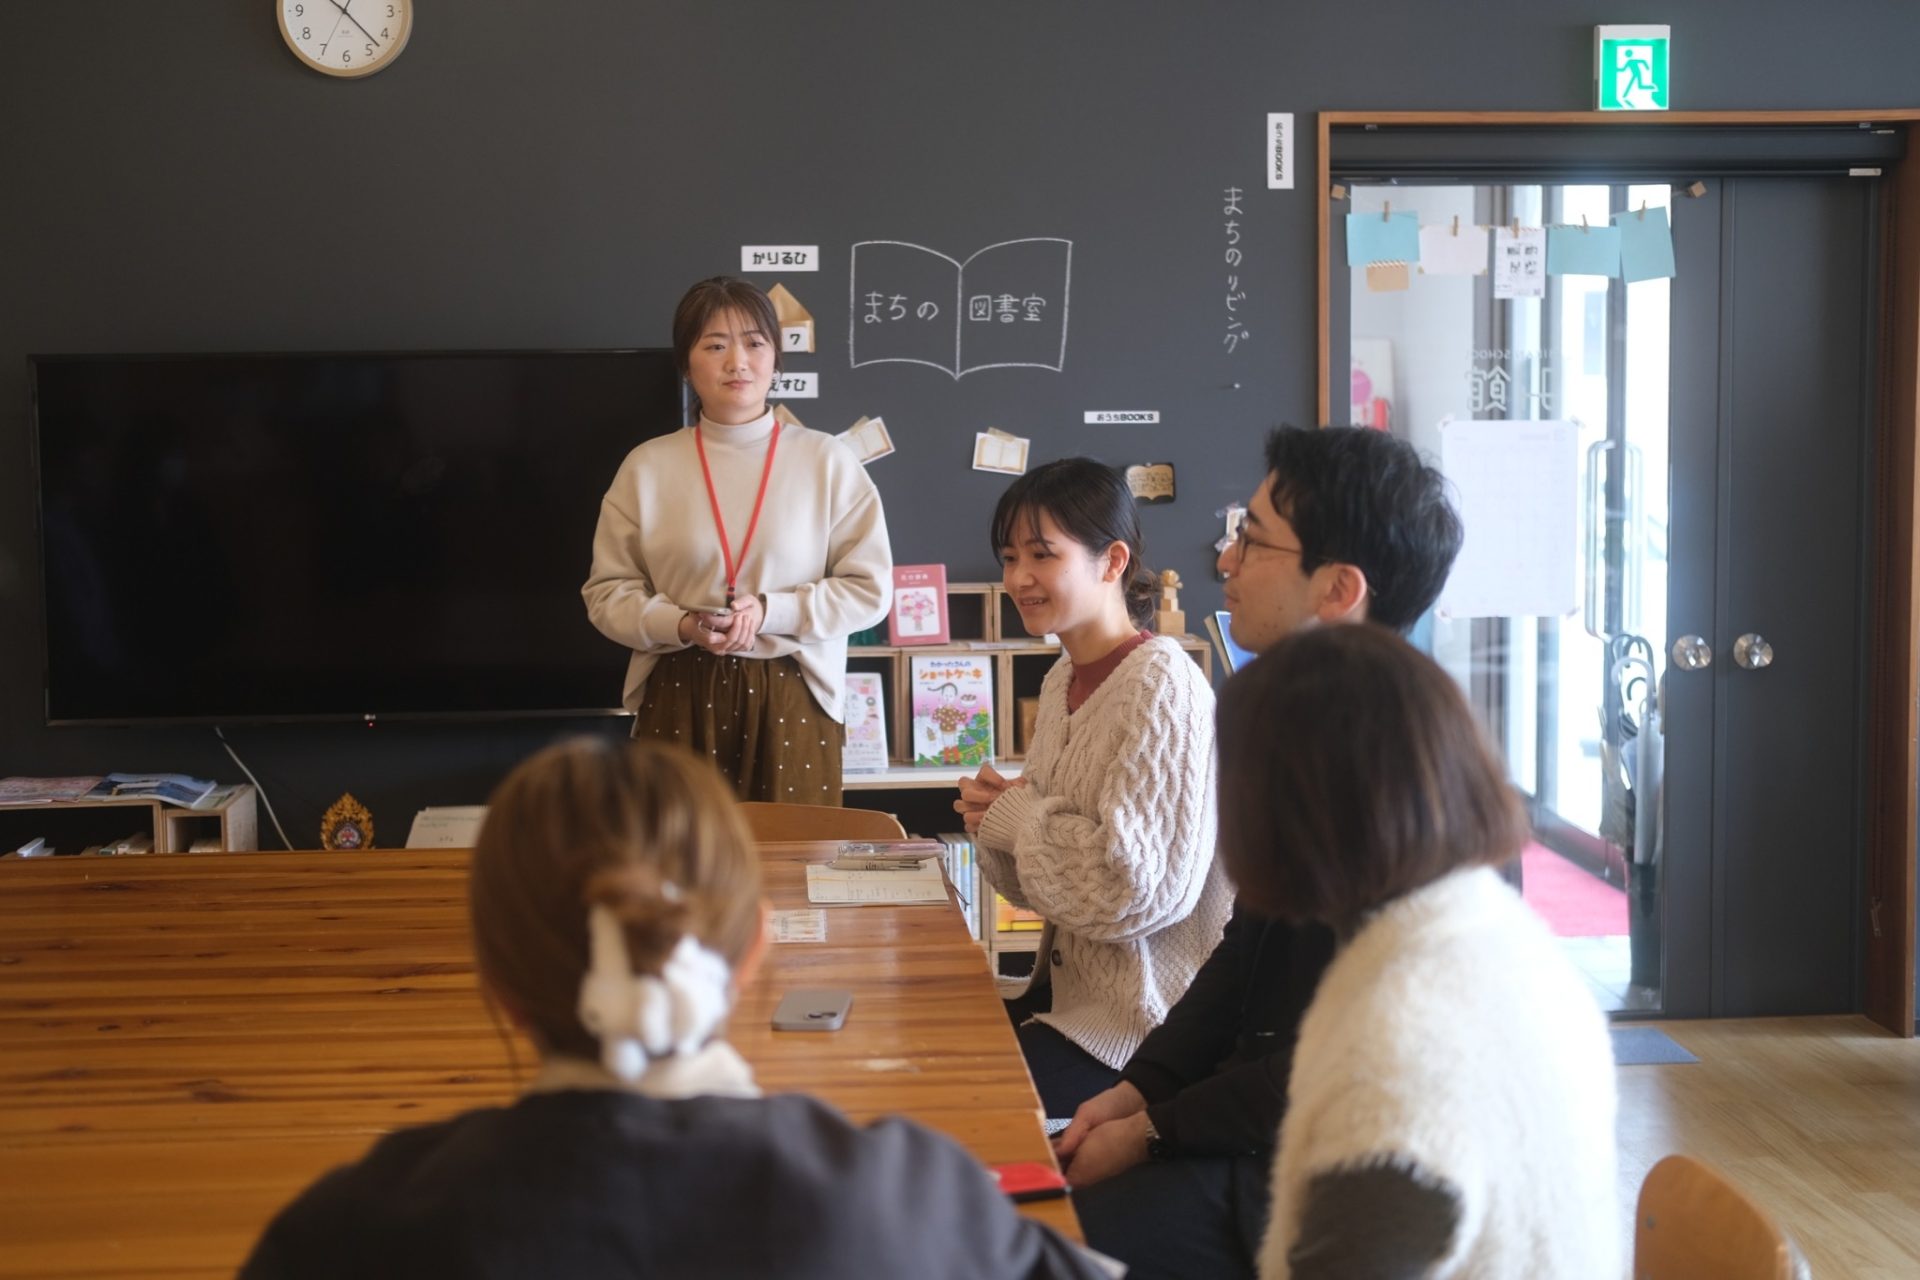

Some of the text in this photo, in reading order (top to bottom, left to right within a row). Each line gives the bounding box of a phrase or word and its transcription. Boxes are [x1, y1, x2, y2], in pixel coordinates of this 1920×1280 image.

[295, 4, 304, 17] 9
[386, 5, 394, 18] 3
[302, 26, 312, 40] 8
[380, 27, 389, 39] 4
[319, 43, 328, 56] 7
[342, 50, 351, 62] 6
[365, 43, 373, 56] 5
[752, 251, 807, 265] かりるひ
[1223, 186, 1249, 354] まちのリビング
[864, 291, 1046, 323] まちの 図書室
[769, 378, 807, 391] えすひ
